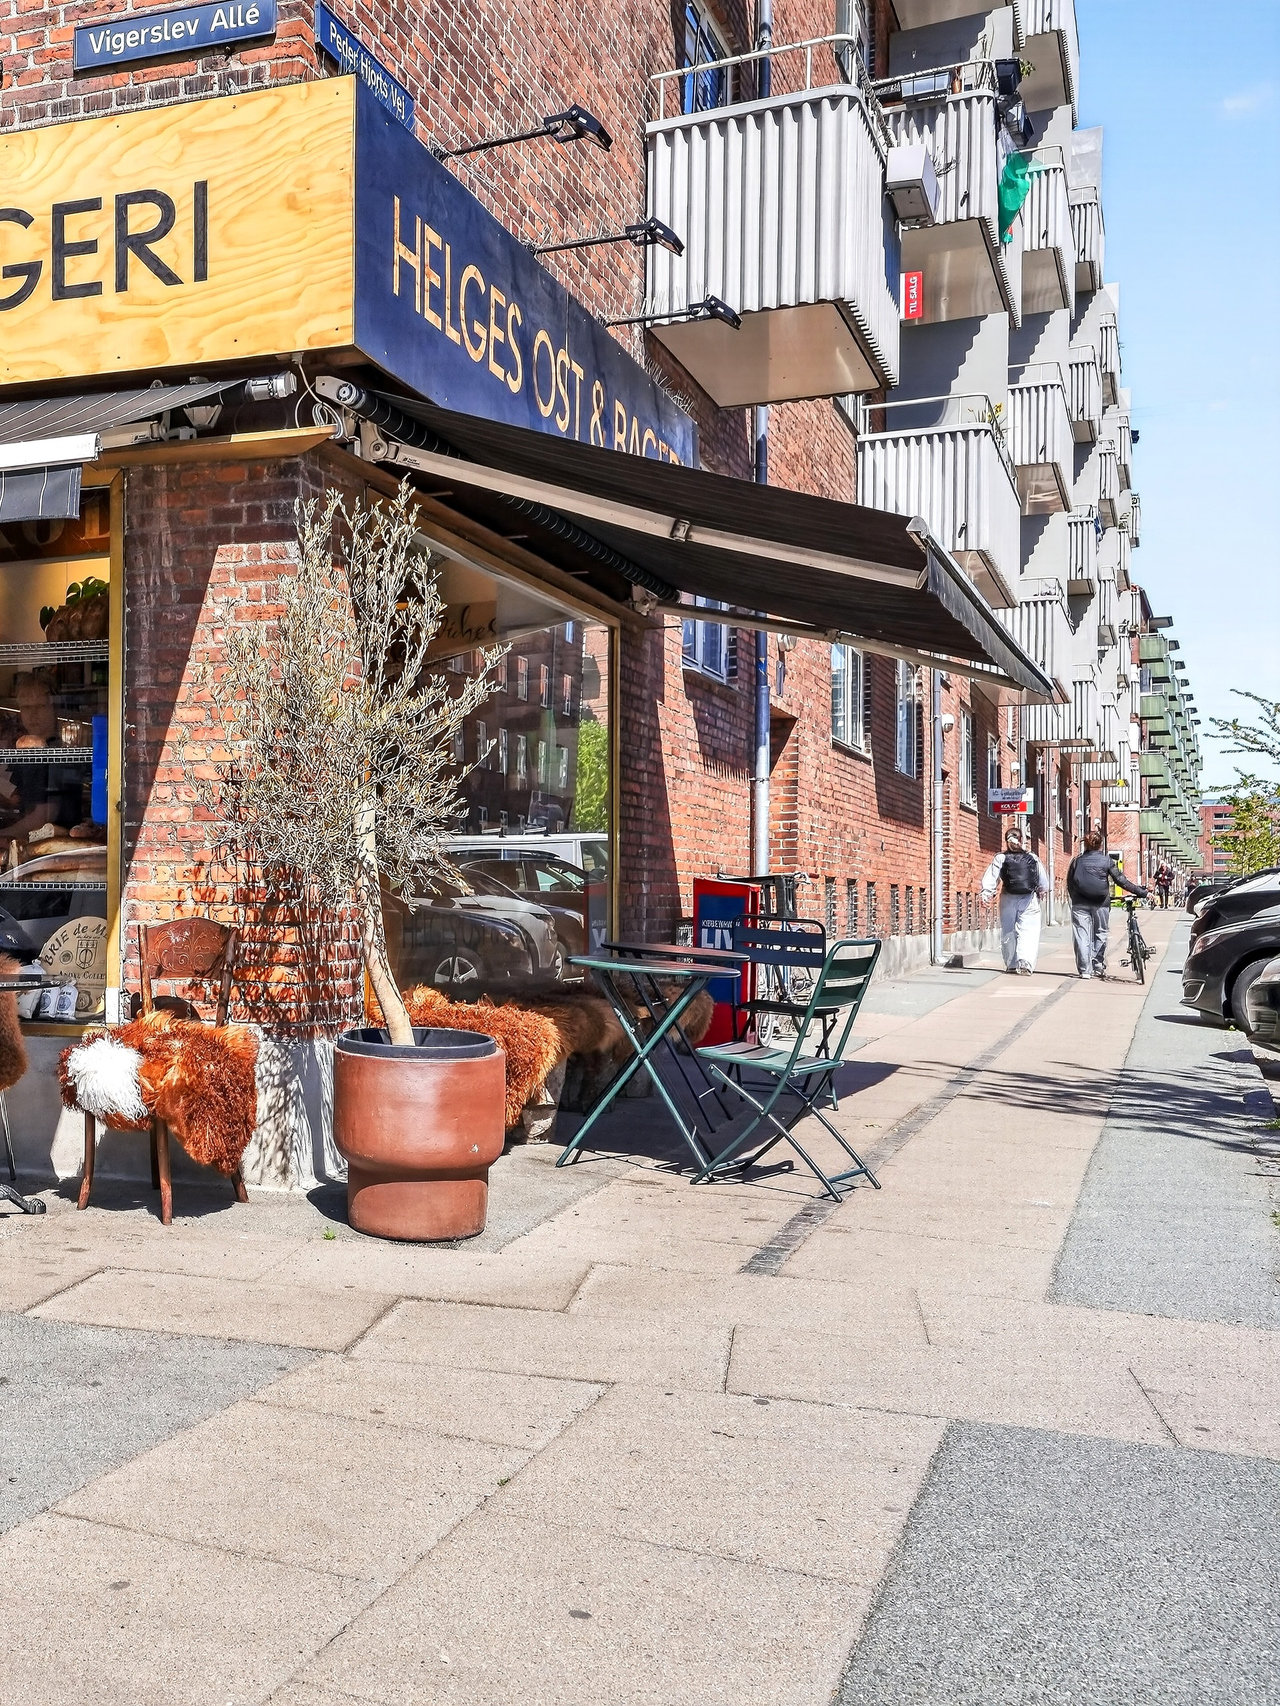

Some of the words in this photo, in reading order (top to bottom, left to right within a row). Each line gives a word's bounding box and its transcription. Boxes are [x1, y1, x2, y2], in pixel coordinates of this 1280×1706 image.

[88, 17, 200, 56] Vigerslev
[210, 2, 260, 32] Allé
[329, 21, 359, 67] Peder
[360, 53, 388, 98] Hjorts
[391, 84, 405, 120] Vej
[909, 275, 918, 300] SALG
[909, 300, 917, 315] TIL
[393, 194, 523, 394] HELGES
[532, 329, 584, 442] OST
[589, 379, 607, 448] &
[44, 930, 70, 967] BRIE
[73, 922, 89, 936] de
